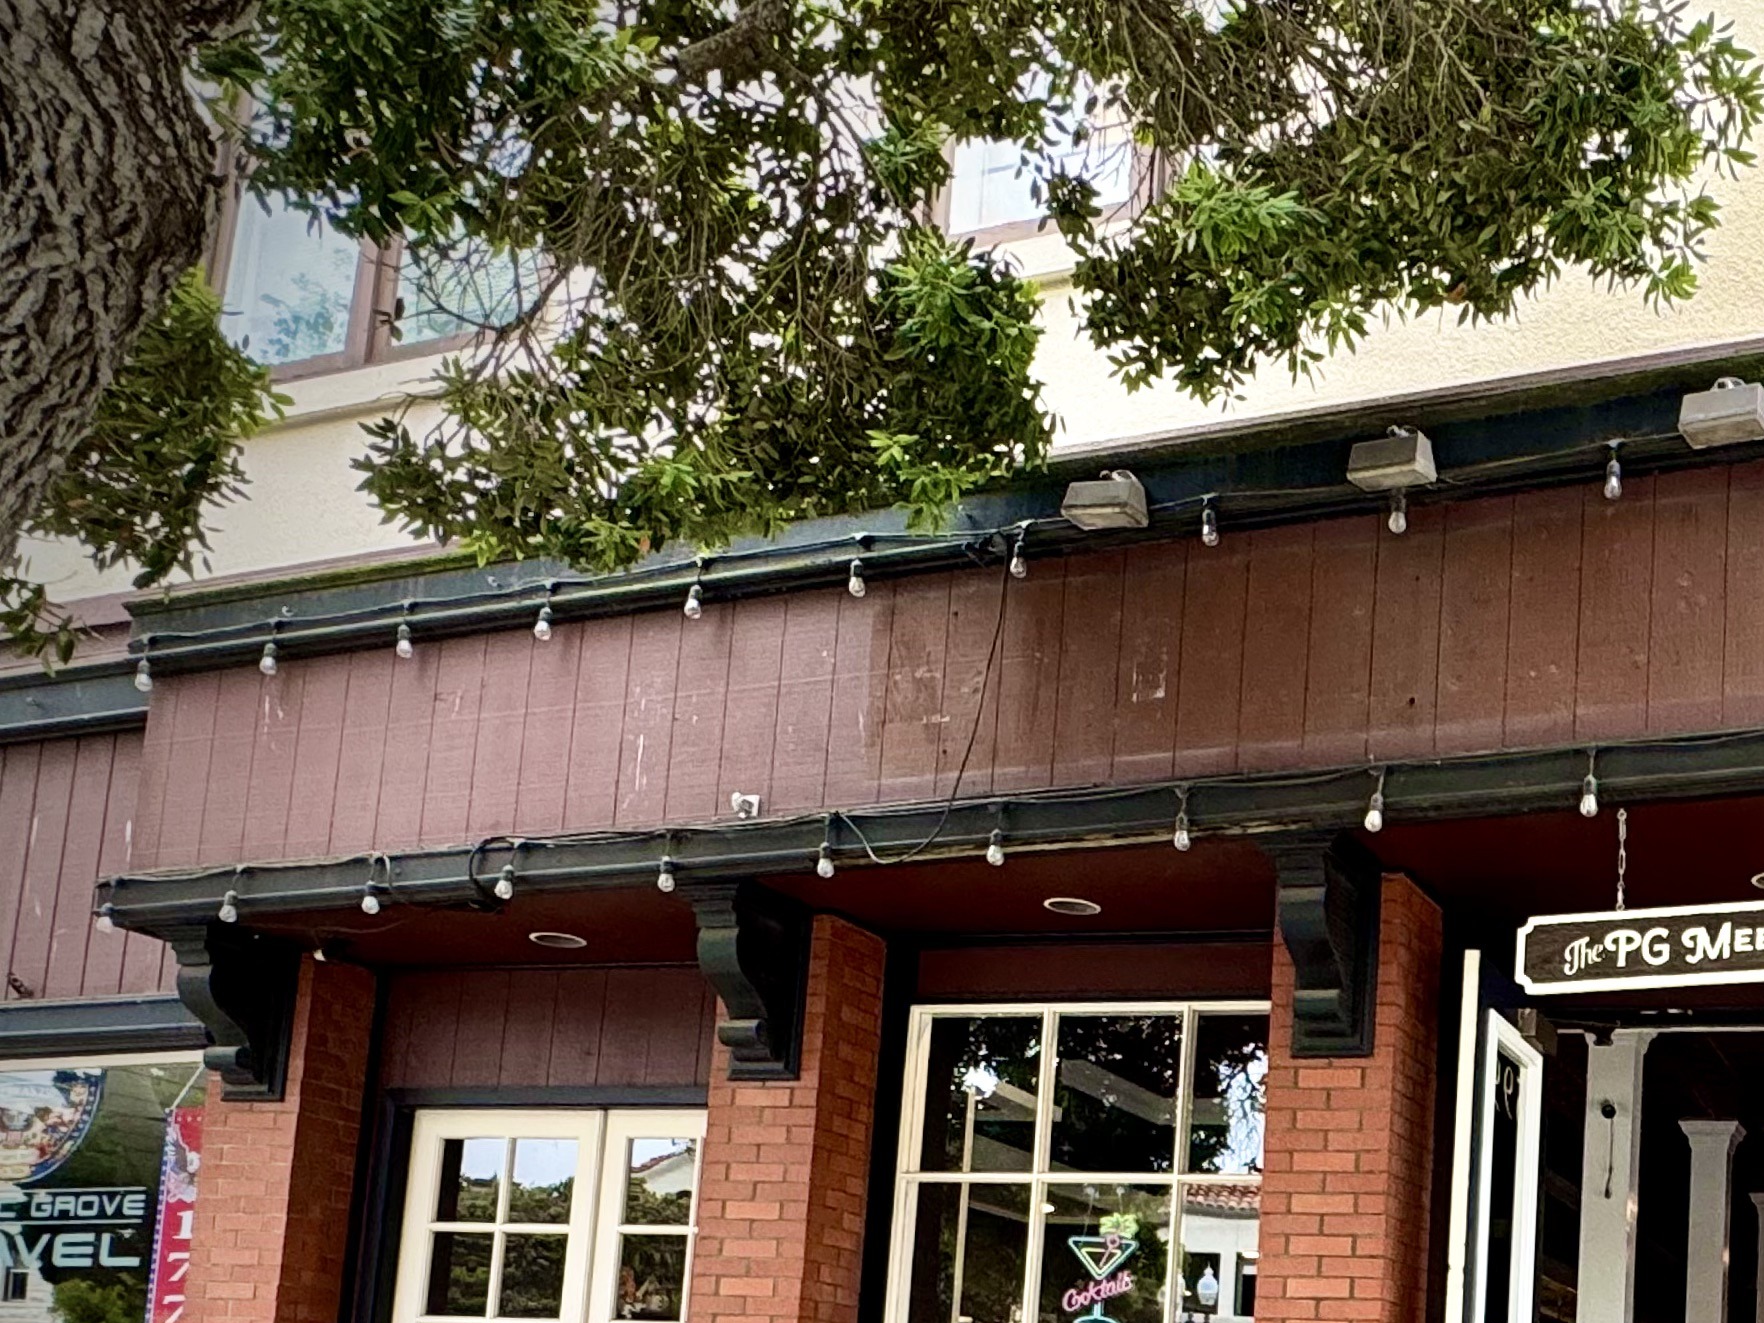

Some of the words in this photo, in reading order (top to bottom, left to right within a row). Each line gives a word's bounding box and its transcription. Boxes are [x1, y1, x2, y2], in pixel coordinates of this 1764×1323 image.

[1563, 936, 1604, 975] The
[1603, 927, 1670, 967] PG
[31, 1193, 147, 1218] GROVE
